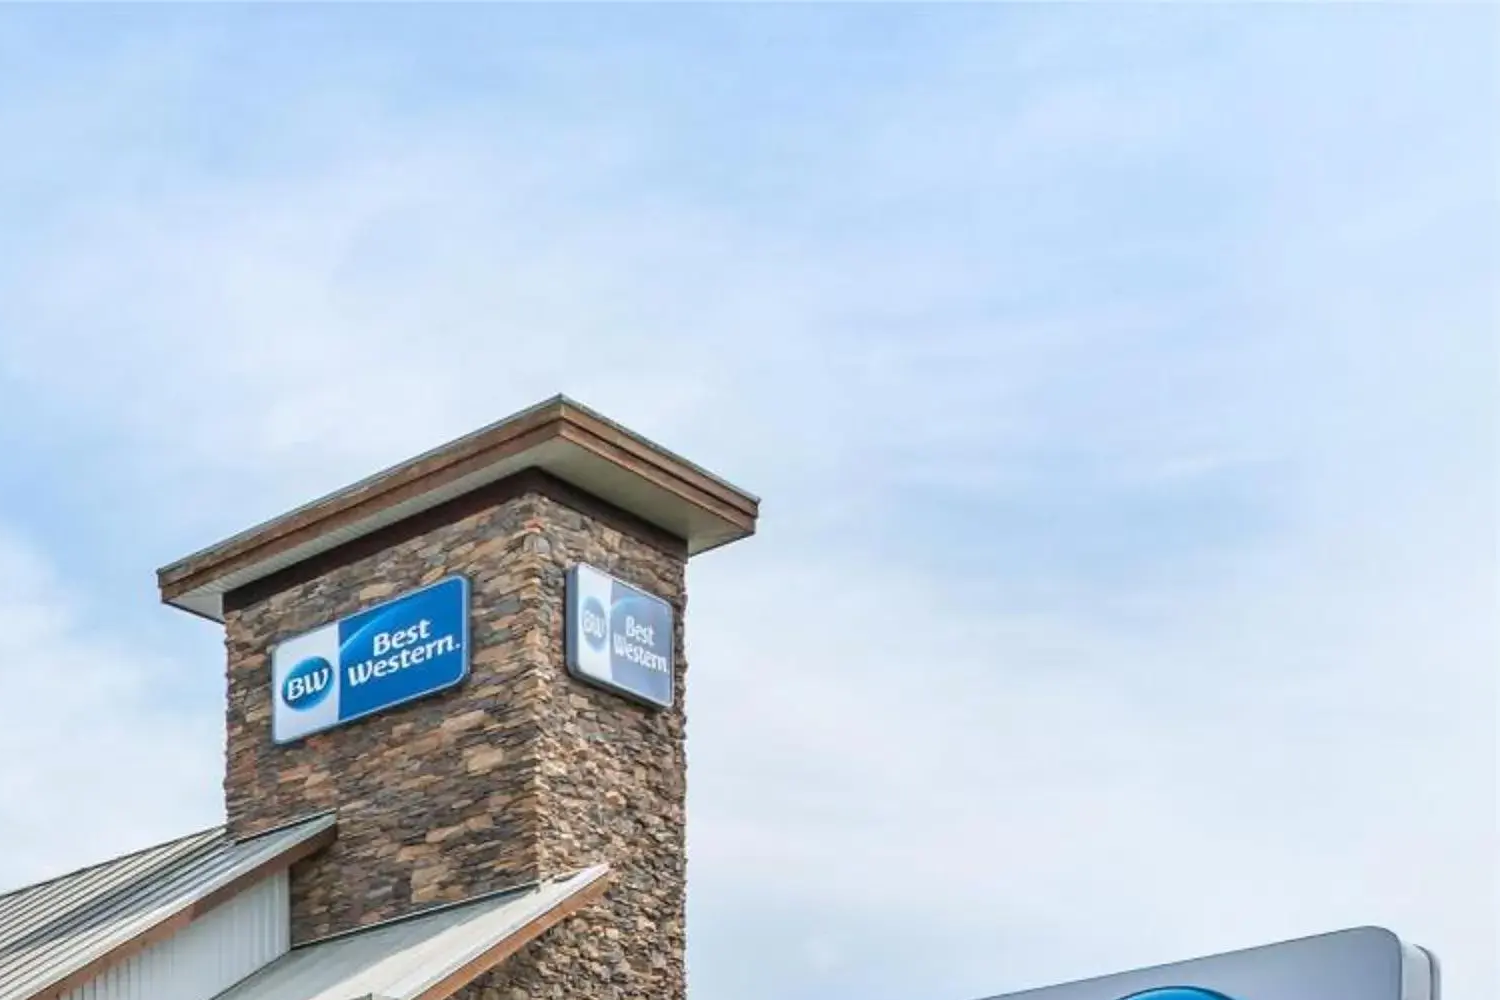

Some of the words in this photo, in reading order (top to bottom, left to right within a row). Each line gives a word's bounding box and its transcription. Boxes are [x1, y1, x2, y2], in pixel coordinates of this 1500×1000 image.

[372, 619, 432, 657] Best
[625, 615, 654, 647] Best
[347, 634, 455, 687] Western
[613, 631, 667, 673] Western
[287, 667, 329, 701] BW
